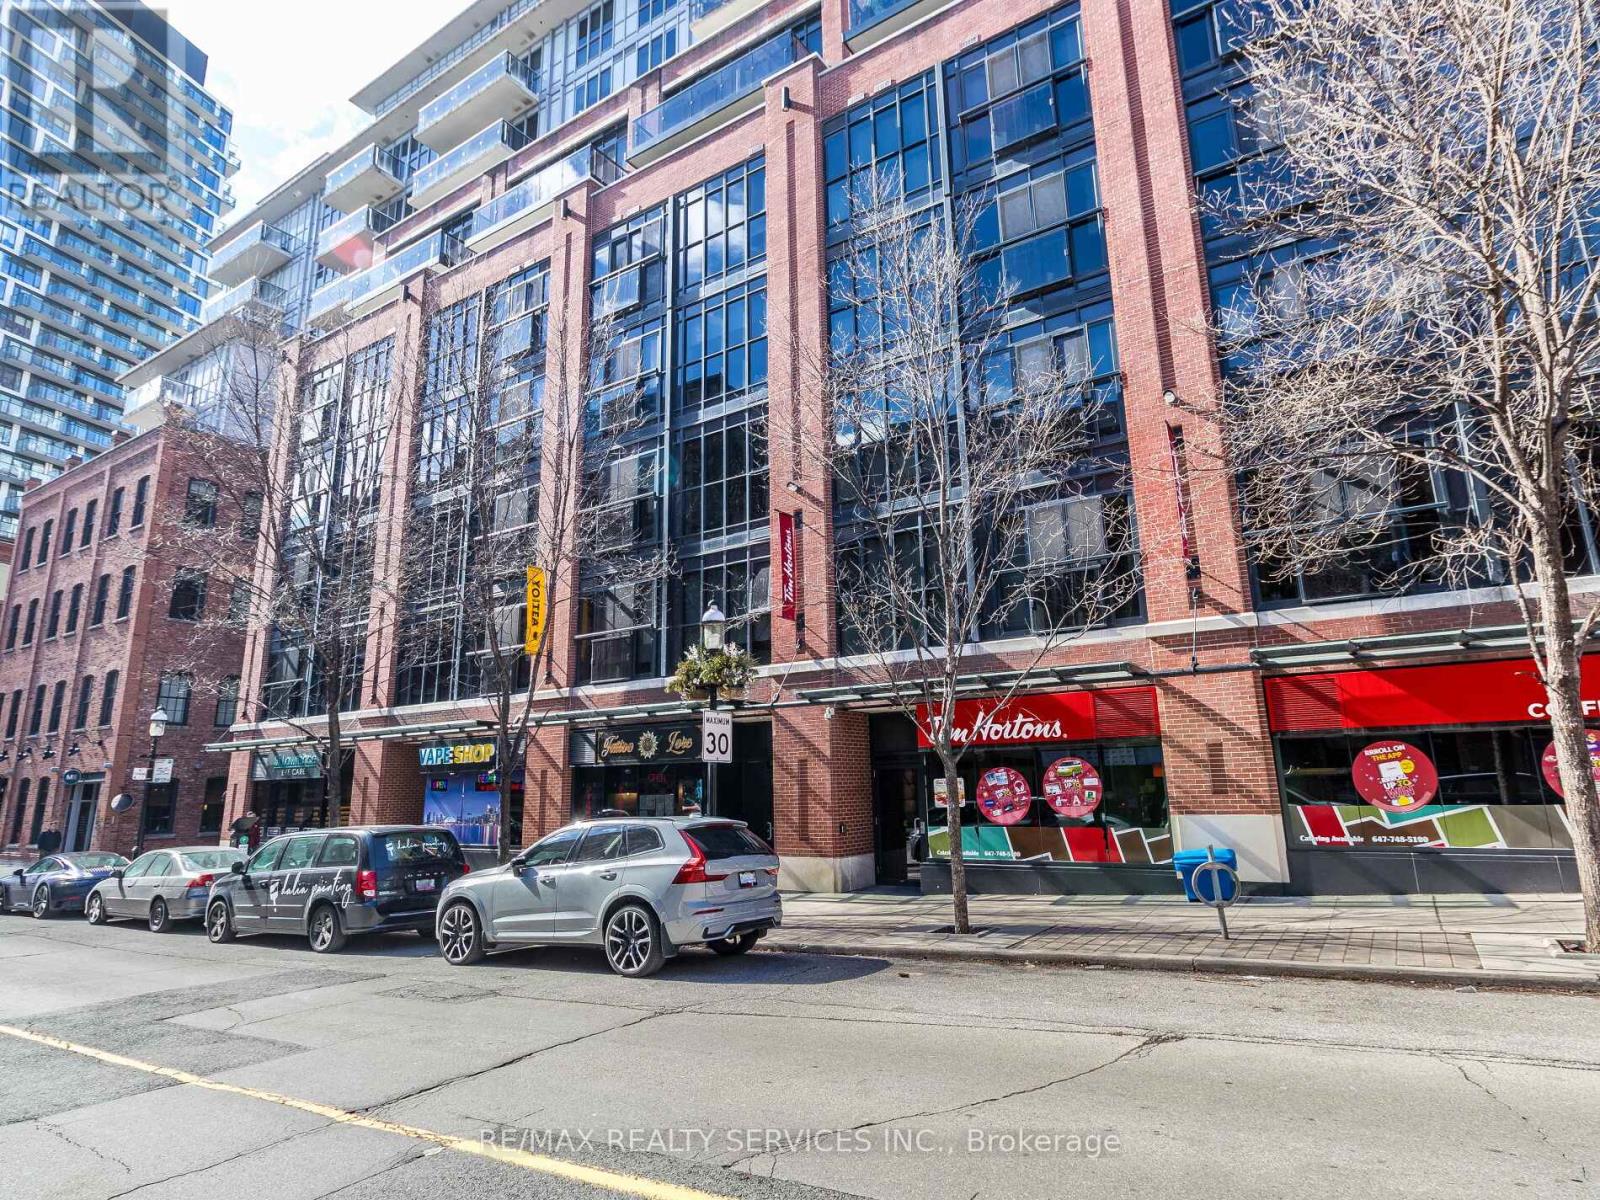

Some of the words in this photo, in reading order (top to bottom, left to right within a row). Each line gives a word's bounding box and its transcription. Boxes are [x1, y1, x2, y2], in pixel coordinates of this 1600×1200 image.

[783, 528, 793, 578] Hortons
[783, 578, 794, 603] Tim
[705, 716, 731, 726] MAXIMUM
[972, 711, 1063, 742] Hortons
[706, 732, 729, 755] 30
[1387, 751, 1402, 760] APP
